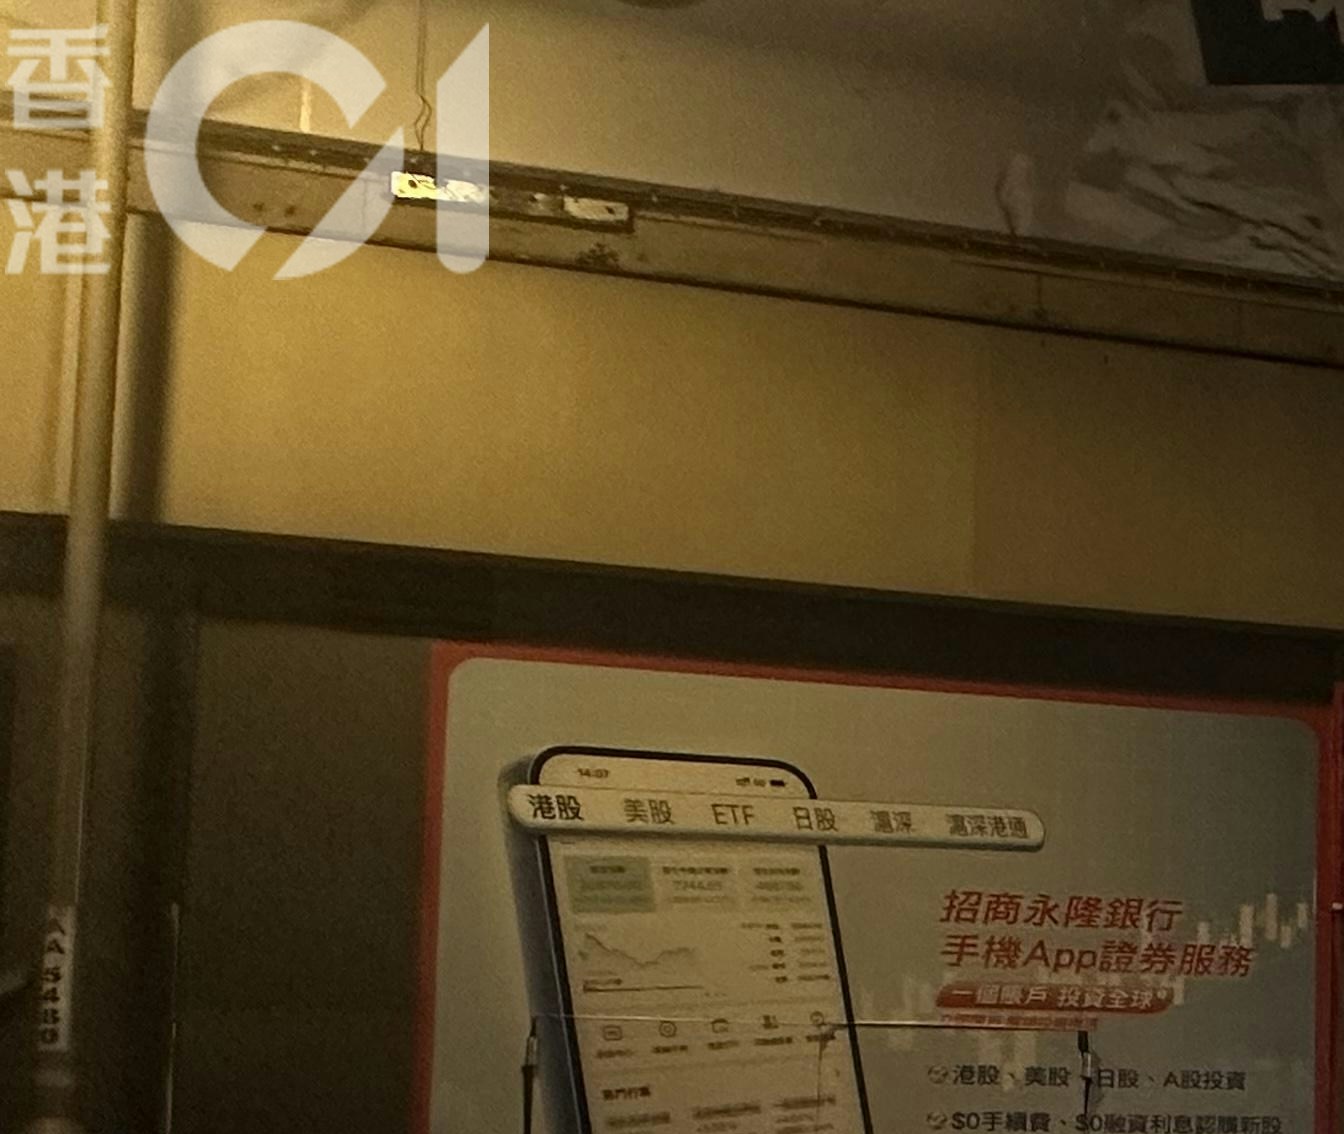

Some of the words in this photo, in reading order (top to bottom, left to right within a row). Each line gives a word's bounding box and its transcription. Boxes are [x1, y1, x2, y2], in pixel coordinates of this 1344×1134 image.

[527, 793, 585, 822] 港股
[622, 797, 677, 825] 美股
[709, 802, 757, 826] ETF
[792, 806, 841, 833] 日股
[939, 888, 1185, 933] 招商永隆銀行
[938, 933, 1258, 979] 手機App證券服務
